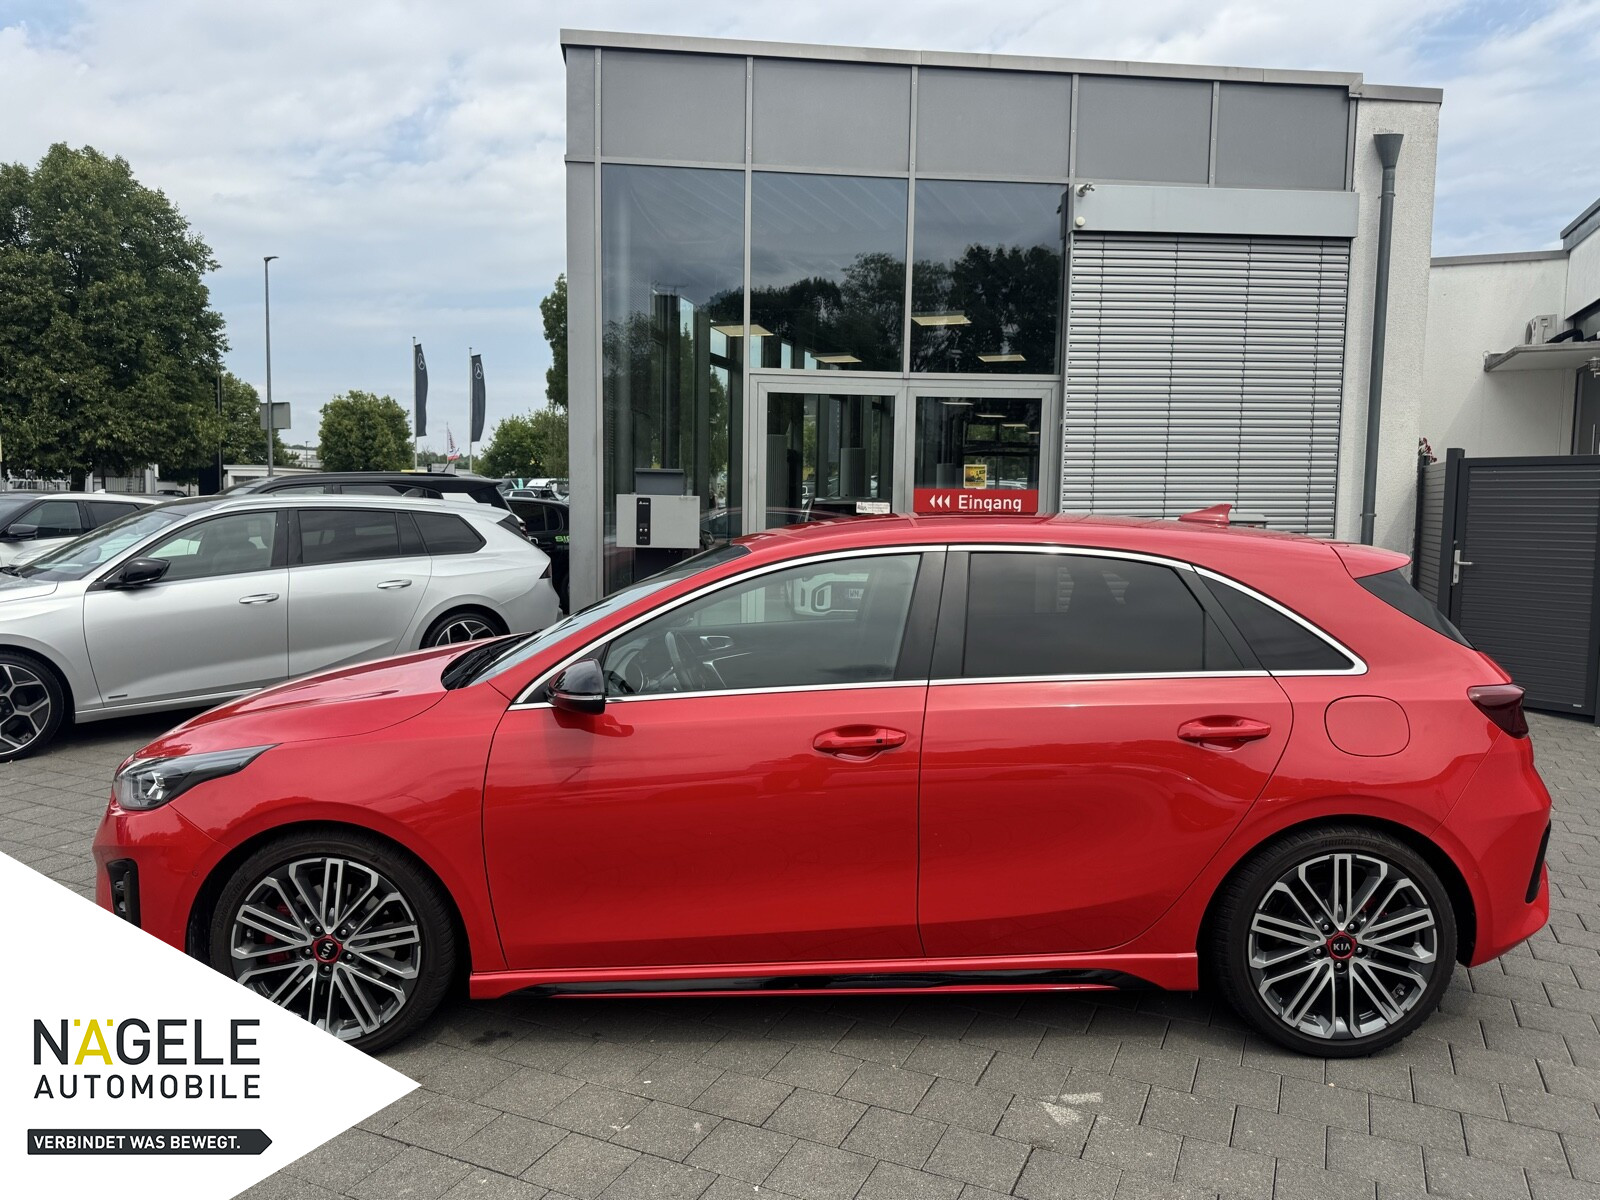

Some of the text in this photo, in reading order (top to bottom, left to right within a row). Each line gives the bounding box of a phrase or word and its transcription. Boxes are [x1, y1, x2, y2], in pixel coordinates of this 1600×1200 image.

[958, 494, 1022, 513] Eingang
[320, 942, 334, 959] KIA
[1333, 943, 1351, 951] KIA
